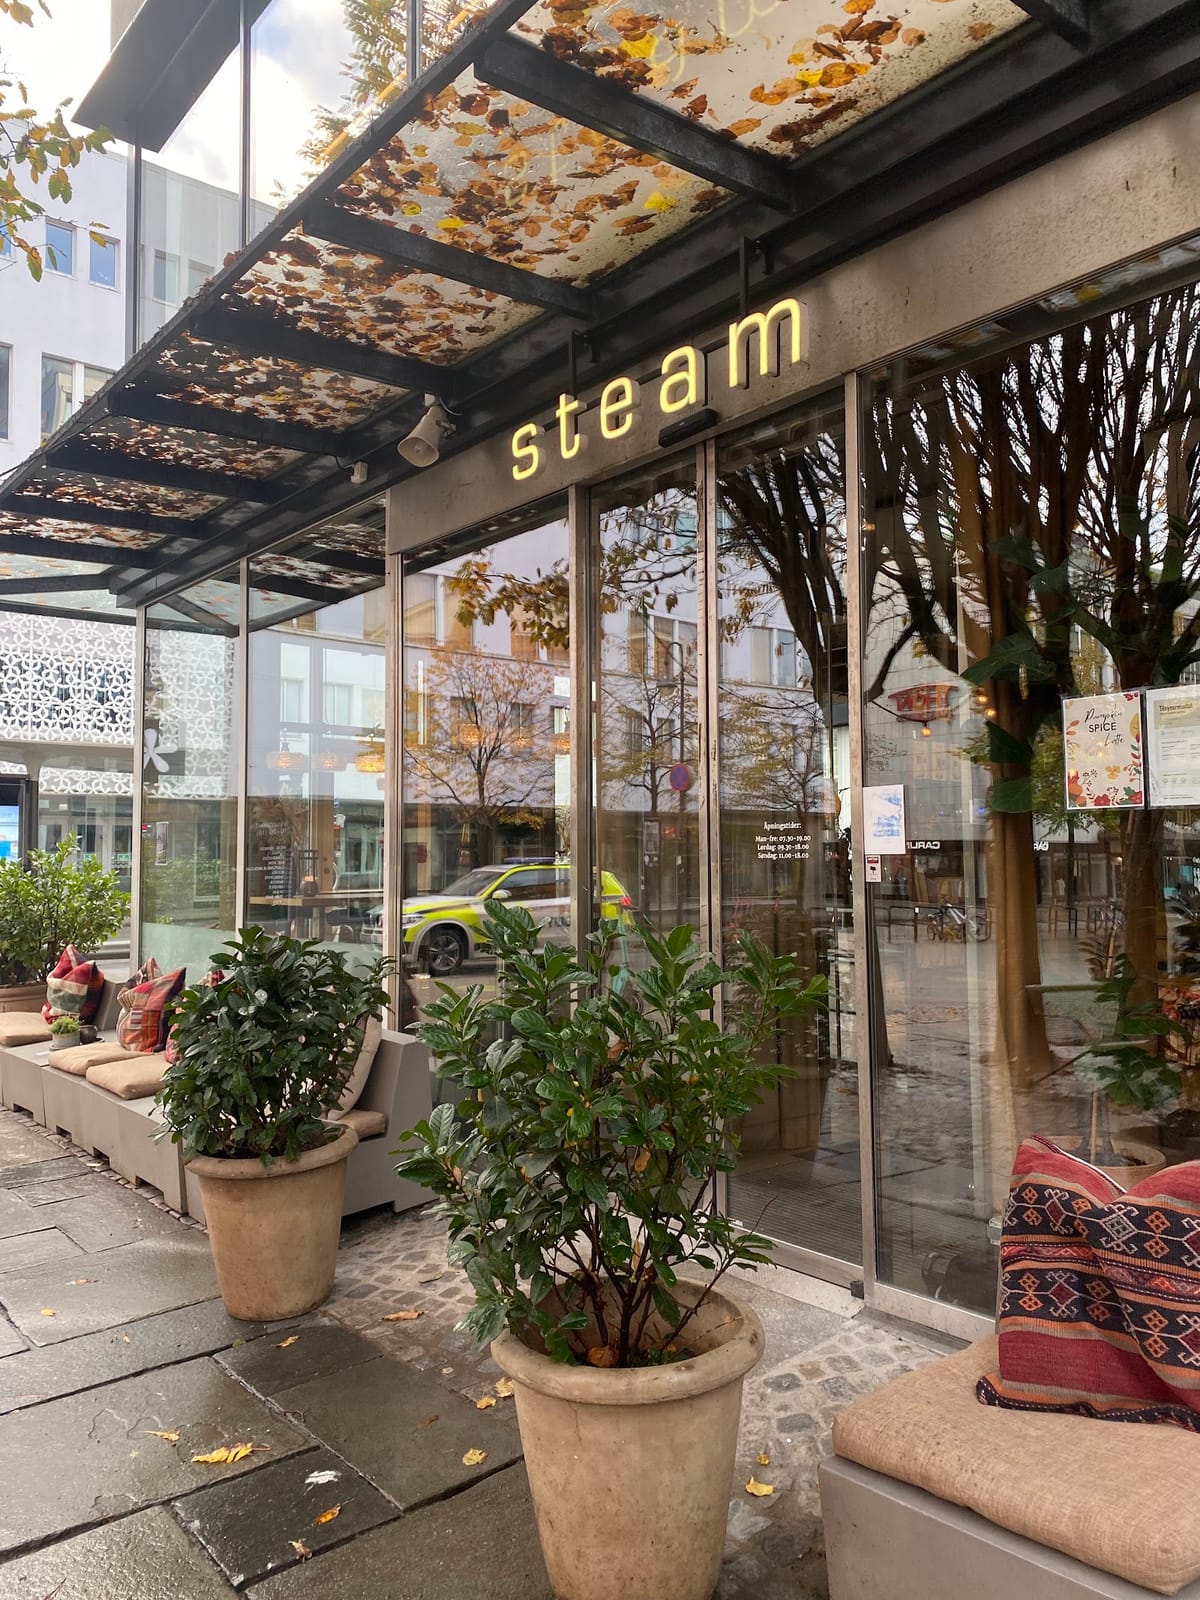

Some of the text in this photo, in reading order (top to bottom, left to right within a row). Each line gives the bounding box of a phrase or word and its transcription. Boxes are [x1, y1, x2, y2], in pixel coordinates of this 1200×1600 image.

[511, 298, 802, 481] steam
[1084, 703, 1123, 723] Pumpkin
[1088, 722, 1117, 733] SPICE
[1104, 733, 1124, 746] Latte
